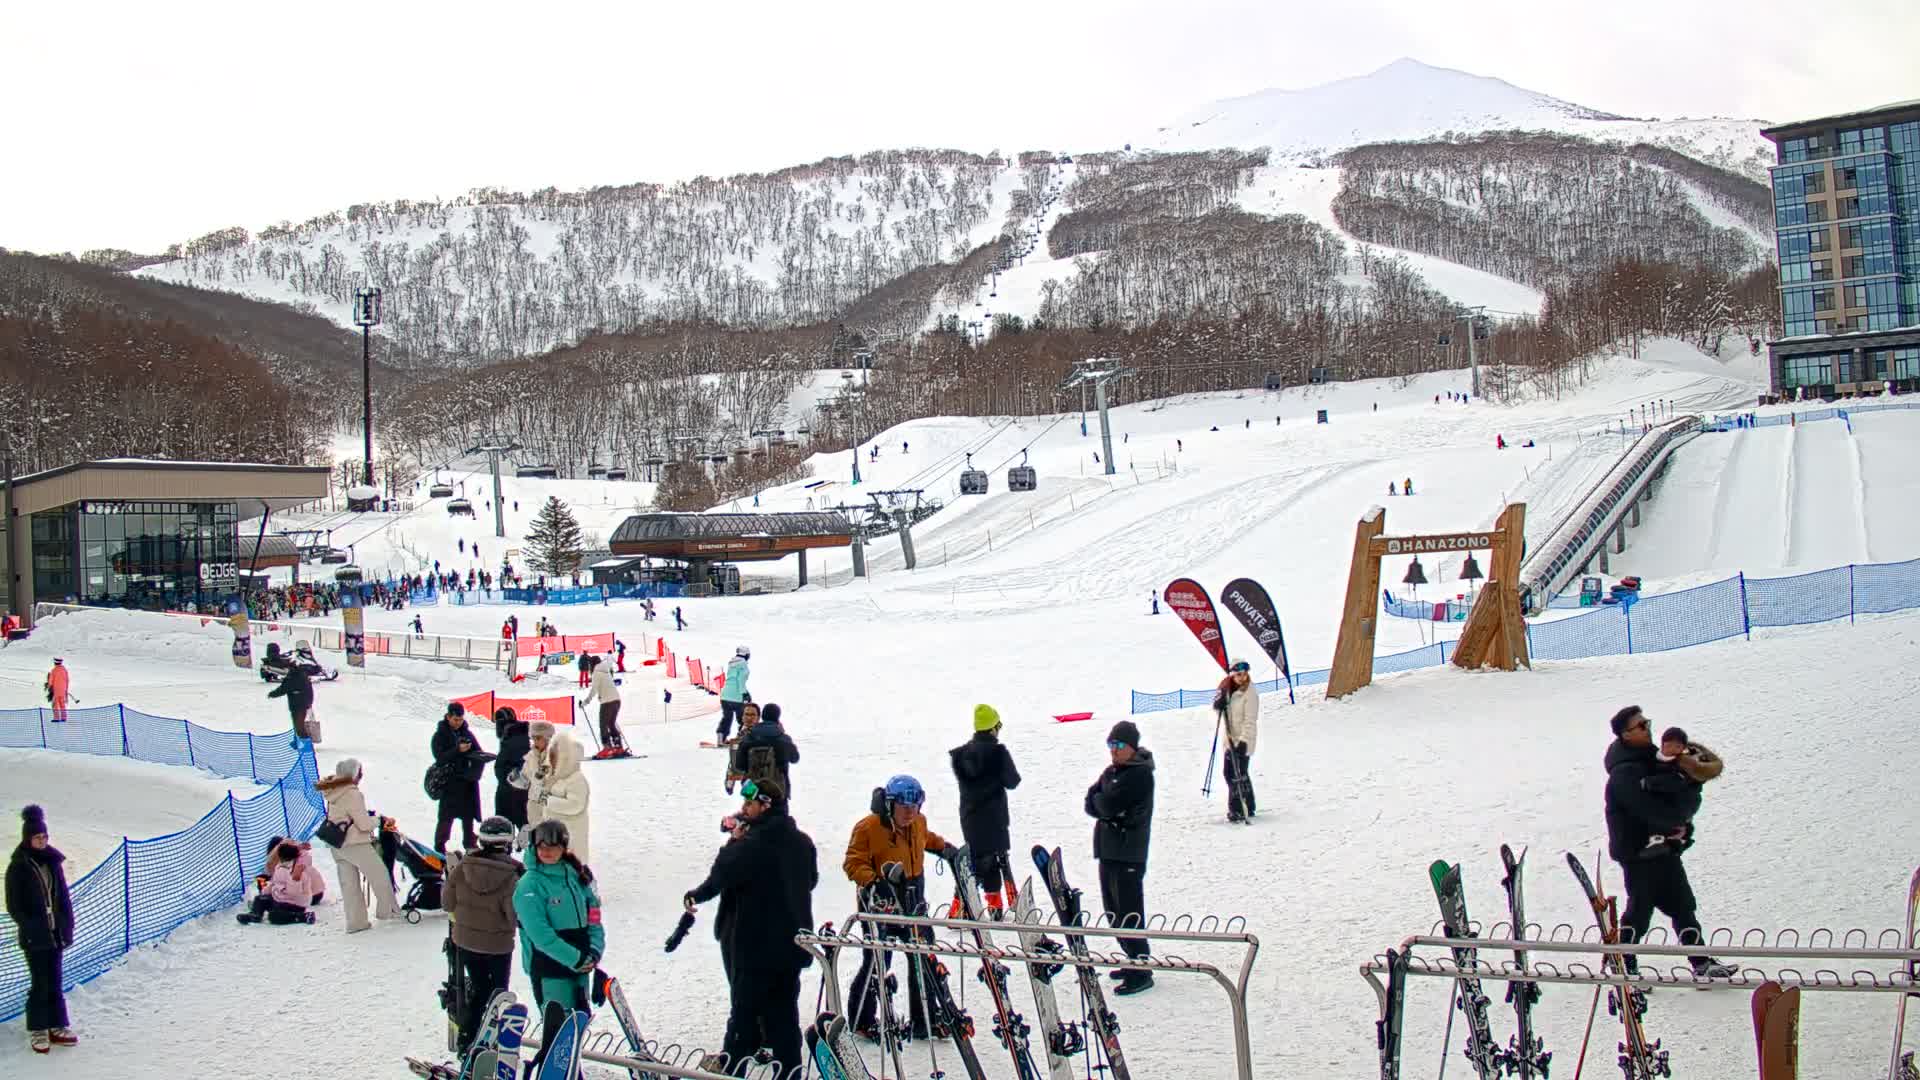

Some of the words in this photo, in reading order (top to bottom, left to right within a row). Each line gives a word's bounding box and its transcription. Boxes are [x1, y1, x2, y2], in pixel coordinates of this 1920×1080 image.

[1403, 536, 1489, 551] HANAZONO
[209, 563, 236, 578] EDGE
[1229, 591, 1268, 628] PRIVATE
